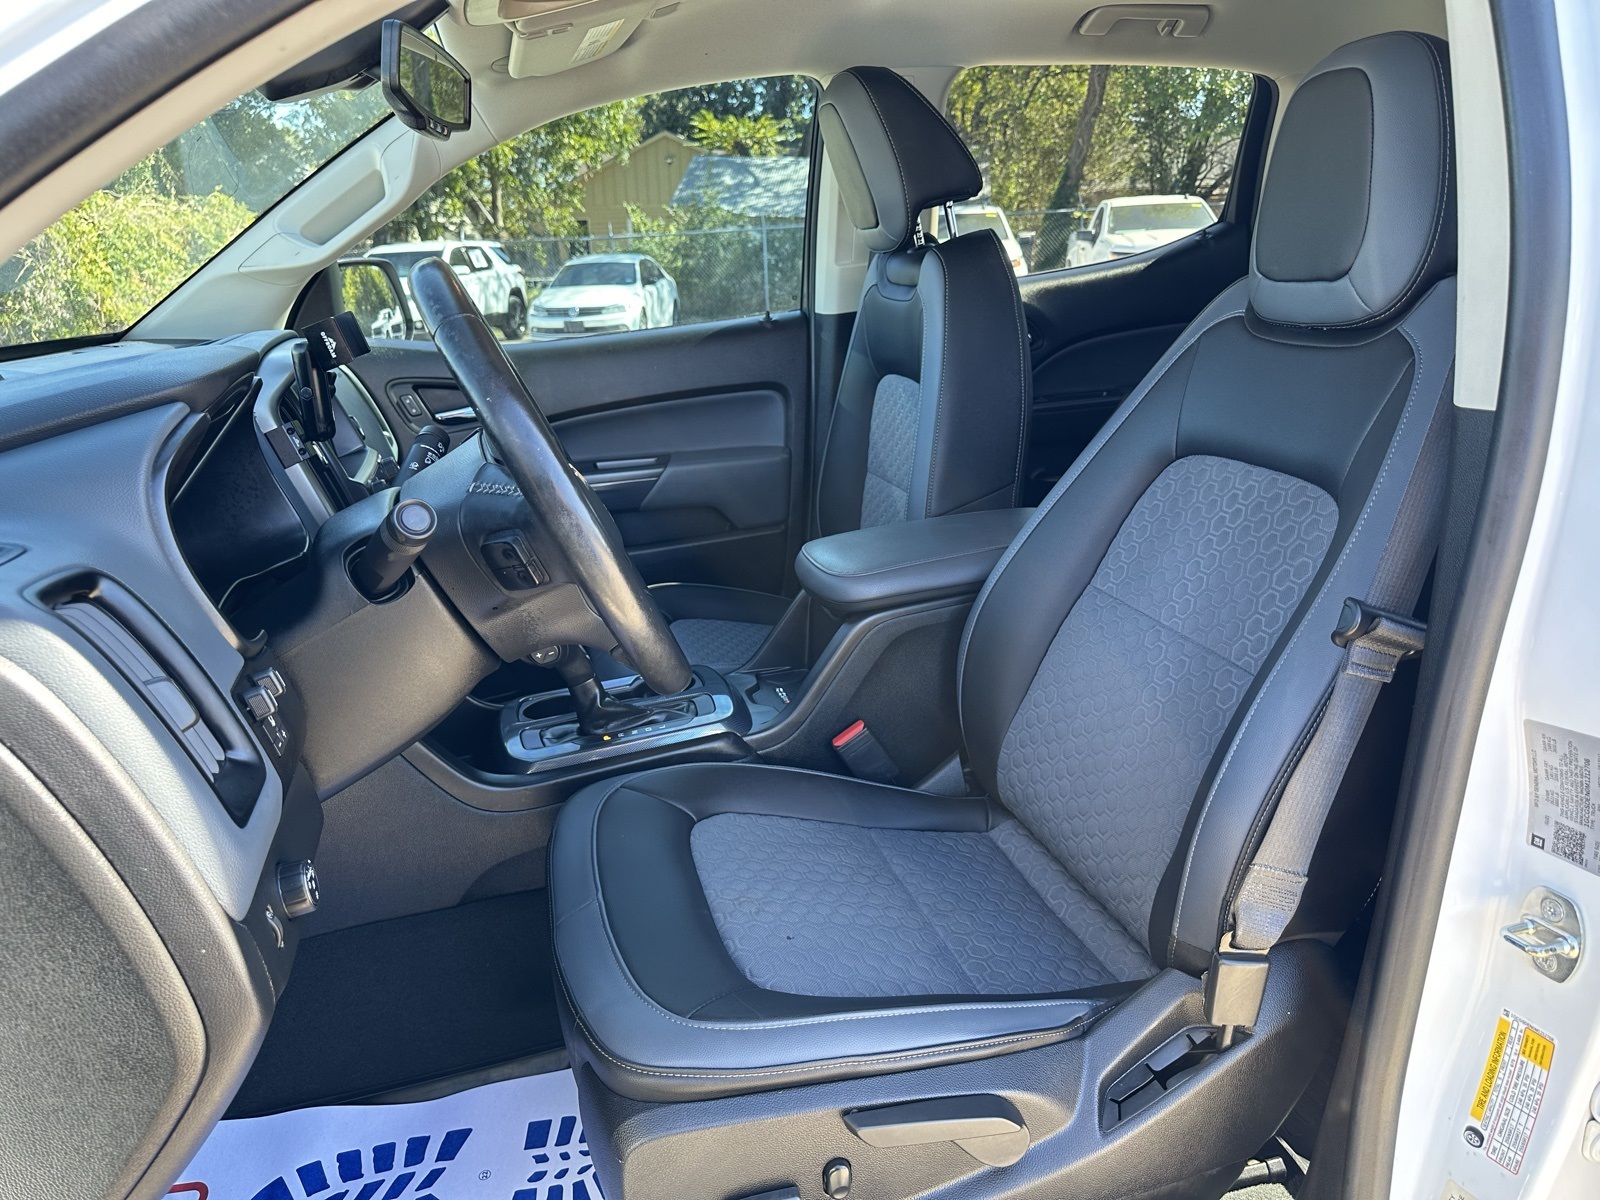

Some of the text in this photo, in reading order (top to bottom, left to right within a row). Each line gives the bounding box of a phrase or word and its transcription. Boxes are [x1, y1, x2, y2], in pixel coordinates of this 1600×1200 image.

[320, 331, 337, 358] OFFROAM
[1477, 1030, 1506, 1111] TIRE AND LOADING INFORMATION
[1487, 1098, 1495, 1114] CAPACITY
[1497, 1116, 1507, 1138] ORIGINAL
[1515, 1059, 1525, 1082] PRESSURE
[1512, 1158, 1520, 1173] SPARE
